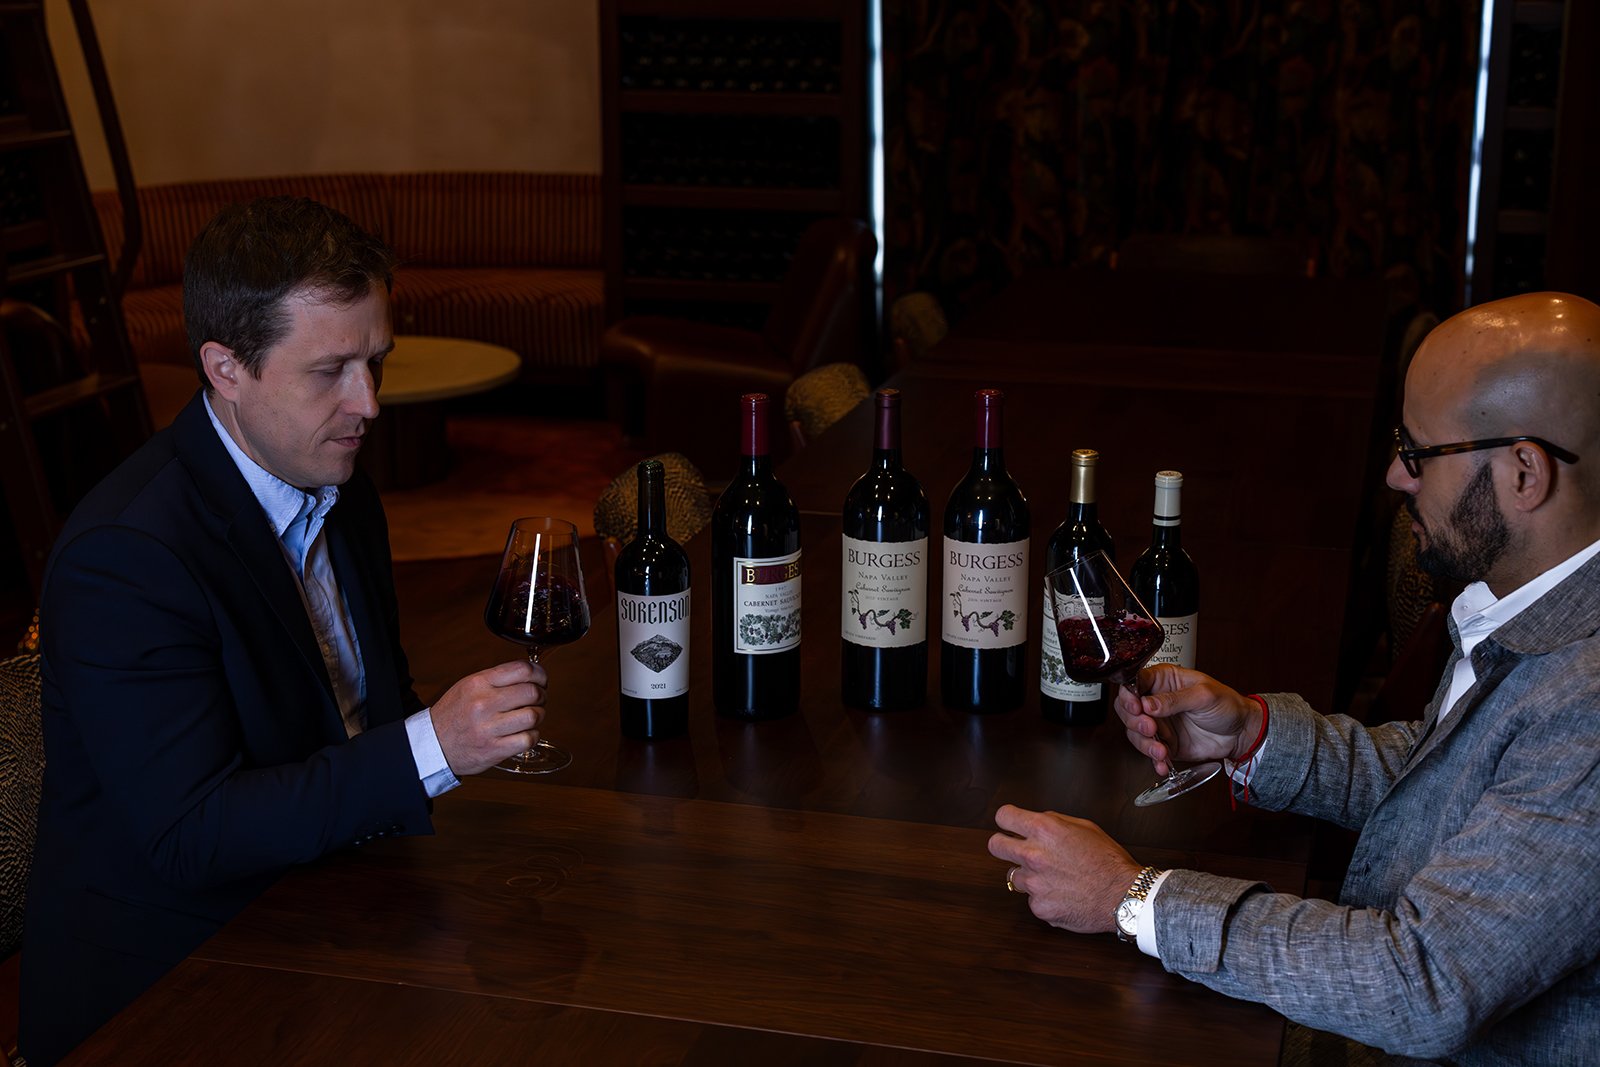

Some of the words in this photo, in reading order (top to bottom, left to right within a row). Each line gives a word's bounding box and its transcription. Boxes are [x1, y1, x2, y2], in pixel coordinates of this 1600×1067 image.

[848, 548, 921, 568] BURGESS
[949, 550, 1023, 570] BURGESS
[858, 571, 878, 581] NAPA
[960, 573, 981, 583] NAPA
[743, 599, 778, 607] CABERNET
[620, 595, 690, 625] SORENSON
[1162, 622, 1190, 636] GESS
[1160, 643, 1183, 655] Valley
[1152, 655, 1179, 663] bernet
